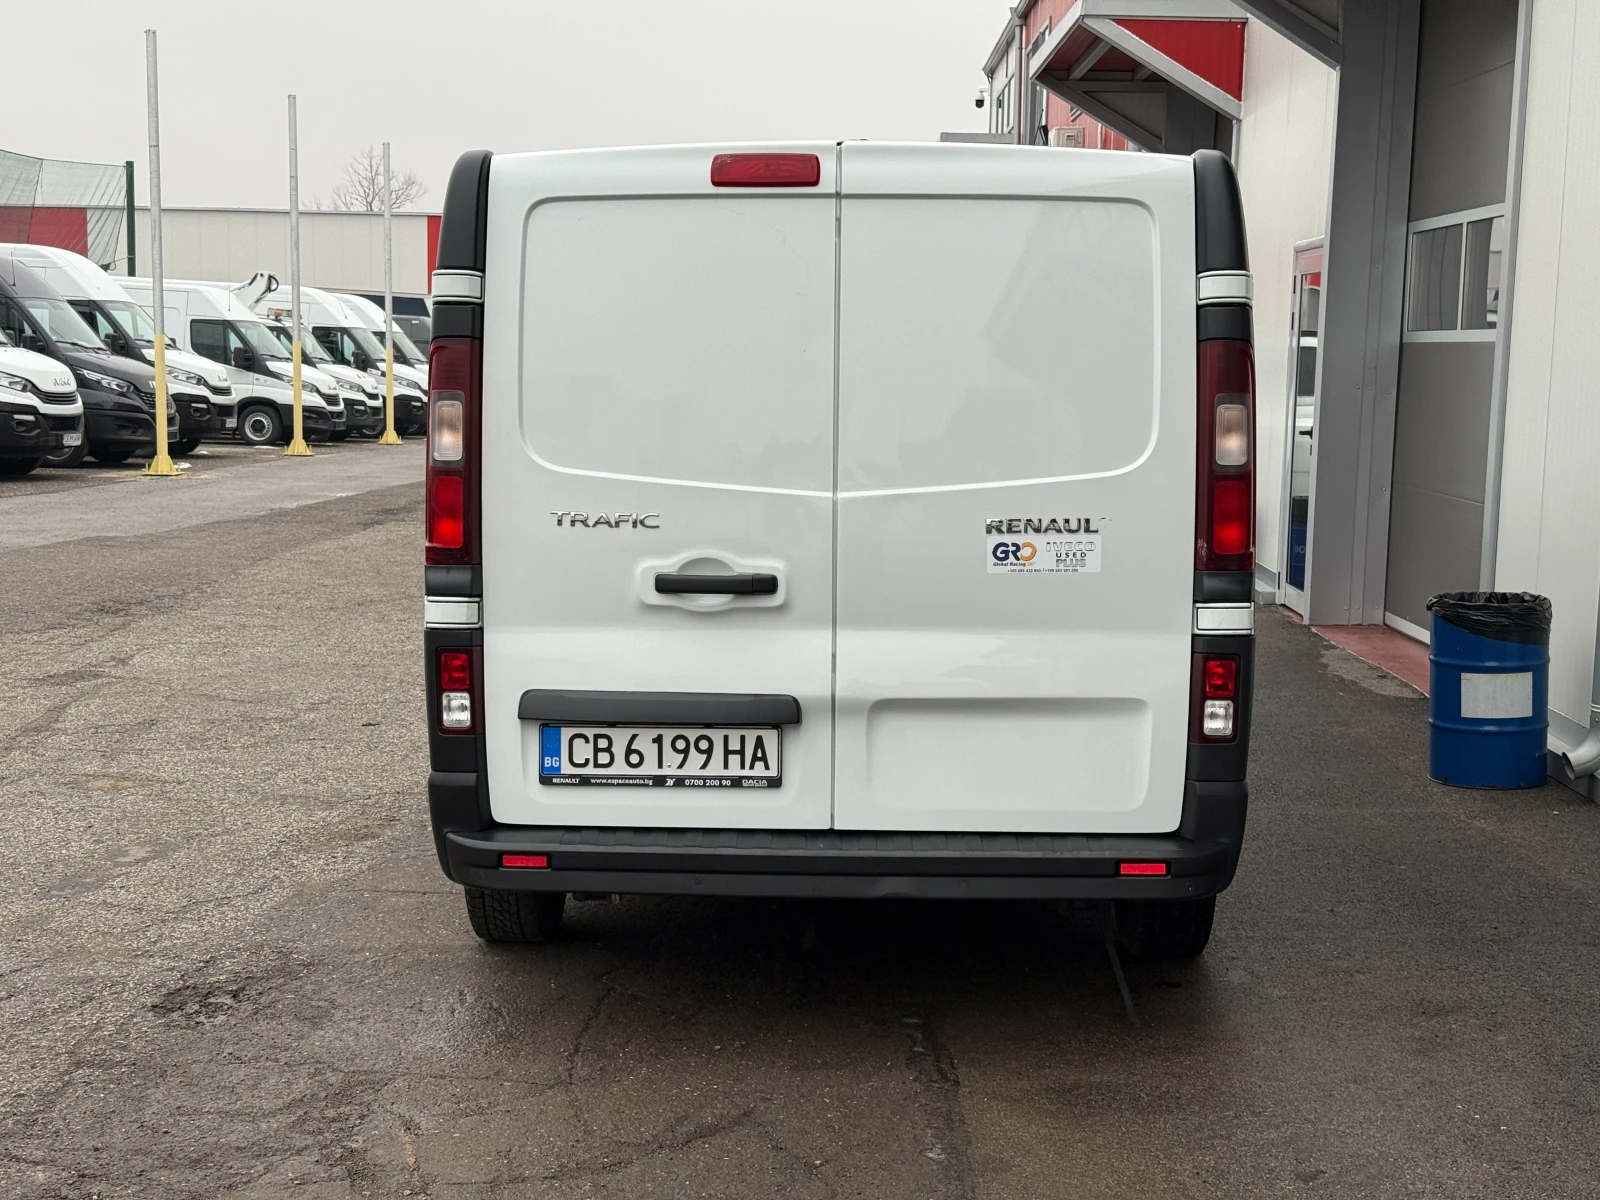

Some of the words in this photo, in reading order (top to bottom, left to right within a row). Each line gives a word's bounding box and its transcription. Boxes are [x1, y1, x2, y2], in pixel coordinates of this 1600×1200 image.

[549, 510, 660, 529] TRAFIC
[985, 517, 1111, 534] RENAUL
[1046, 541, 1096, 552] IVECO
[1056, 558, 1086, 567] PLUS
[568, 733, 615, 769] CB
[624, 733, 714, 770] 6199
[723, 734, 770, 770] HA
[544, 756, 560, 768] BG
